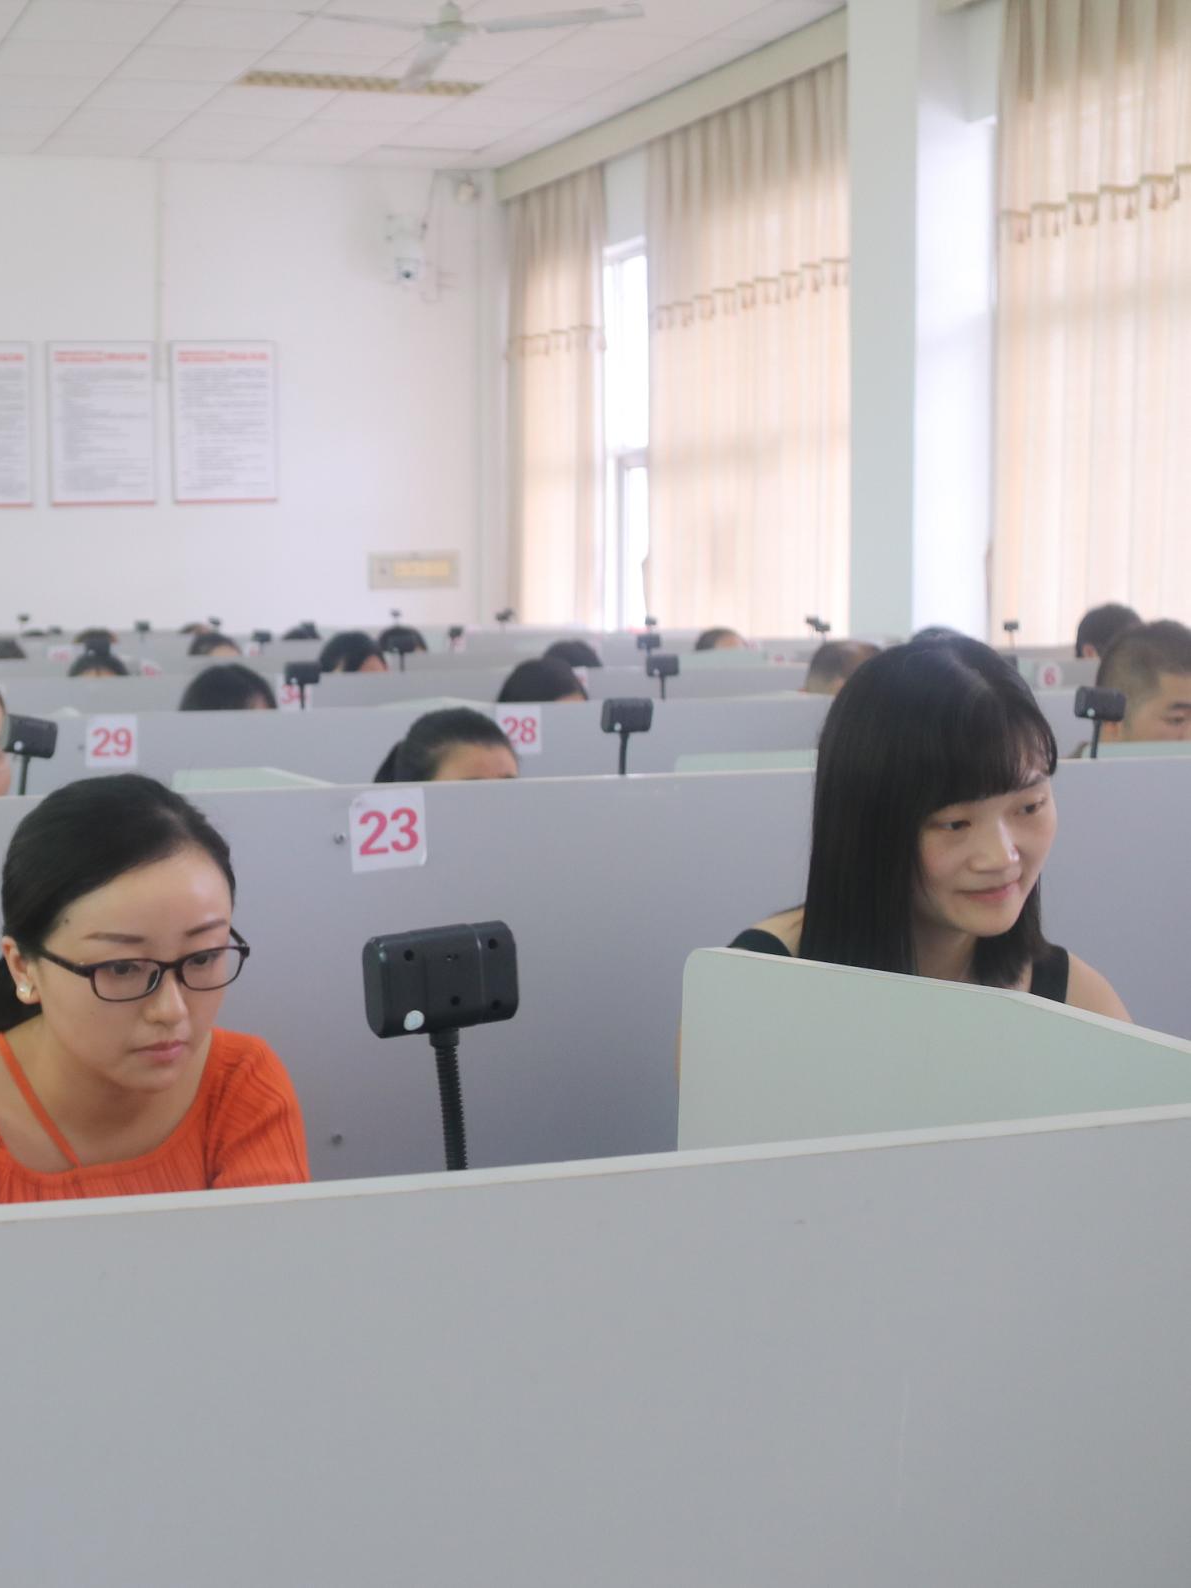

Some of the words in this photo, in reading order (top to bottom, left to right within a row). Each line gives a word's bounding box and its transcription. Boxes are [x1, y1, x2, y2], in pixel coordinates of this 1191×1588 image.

[92, 728, 133, 758] 29
[502, 716, 537, 745] 28
[358, 807, 420, 856] 23
